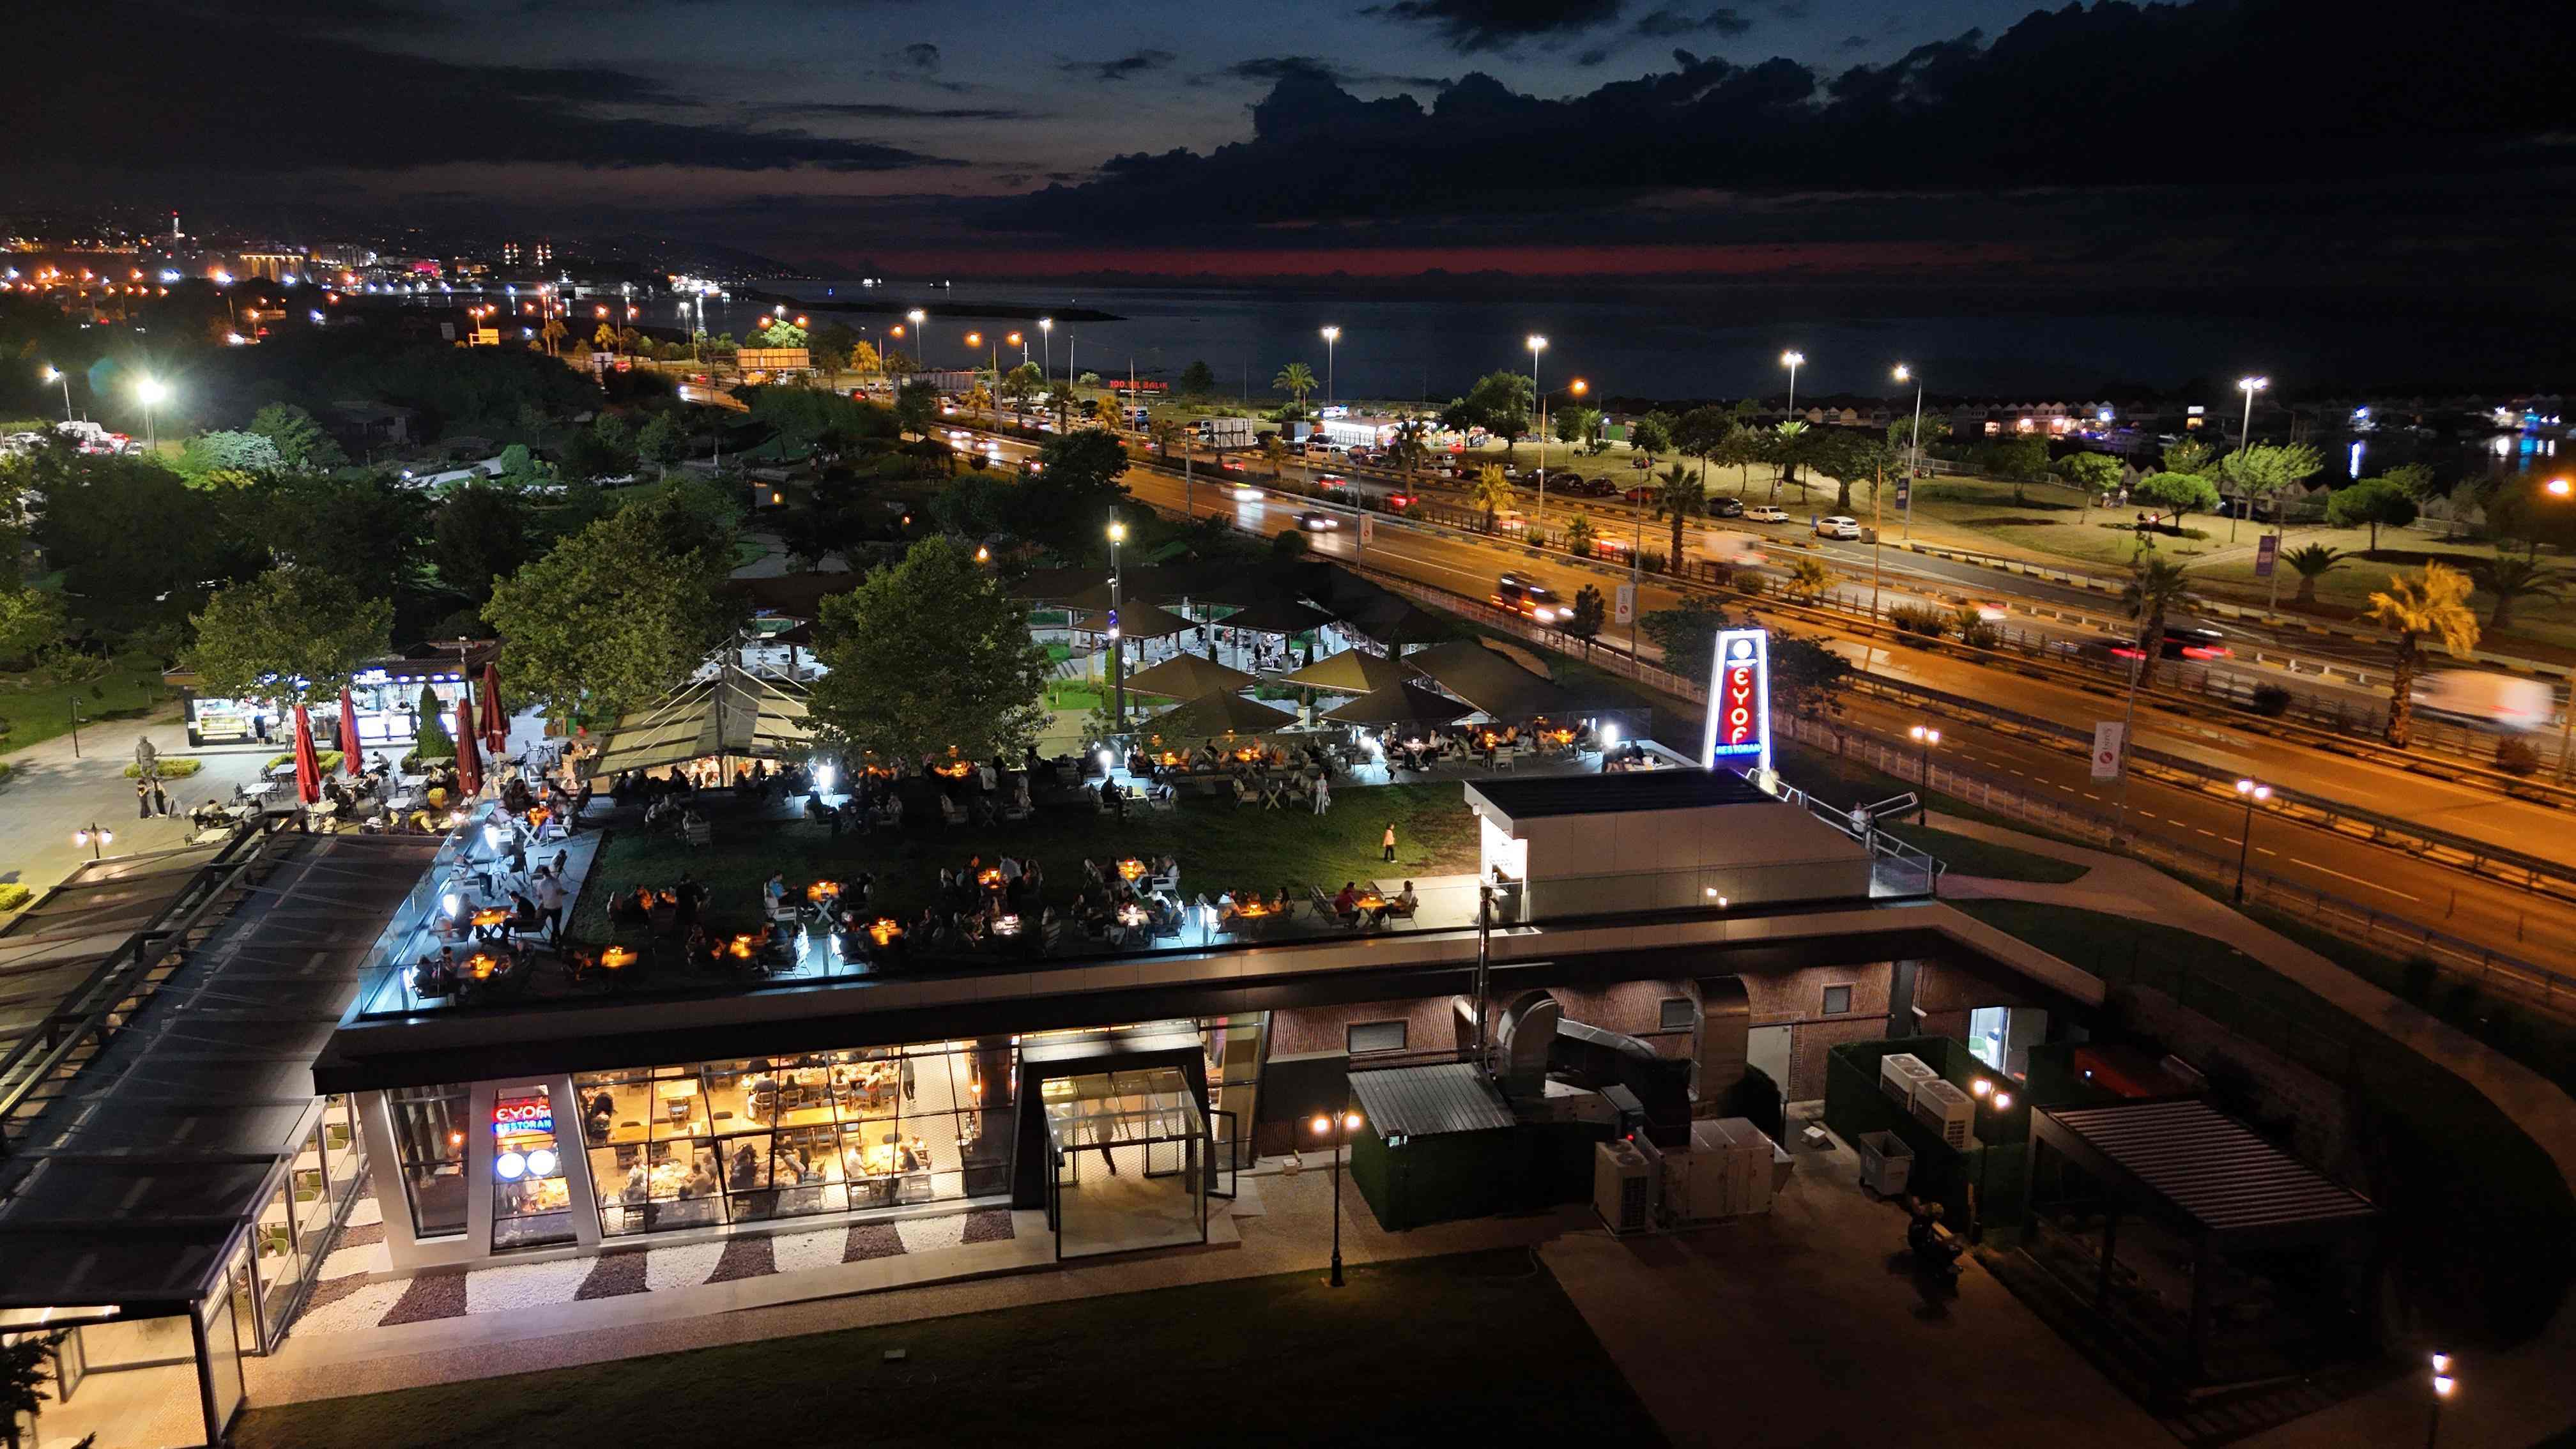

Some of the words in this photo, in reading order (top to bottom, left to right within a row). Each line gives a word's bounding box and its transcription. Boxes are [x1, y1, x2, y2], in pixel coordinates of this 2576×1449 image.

[1731, 668, 1749, 744] EYOF
[1717, 744, 1761, 754] RESTORAN
[496, 1120, 551, 1131] RESTORAN
